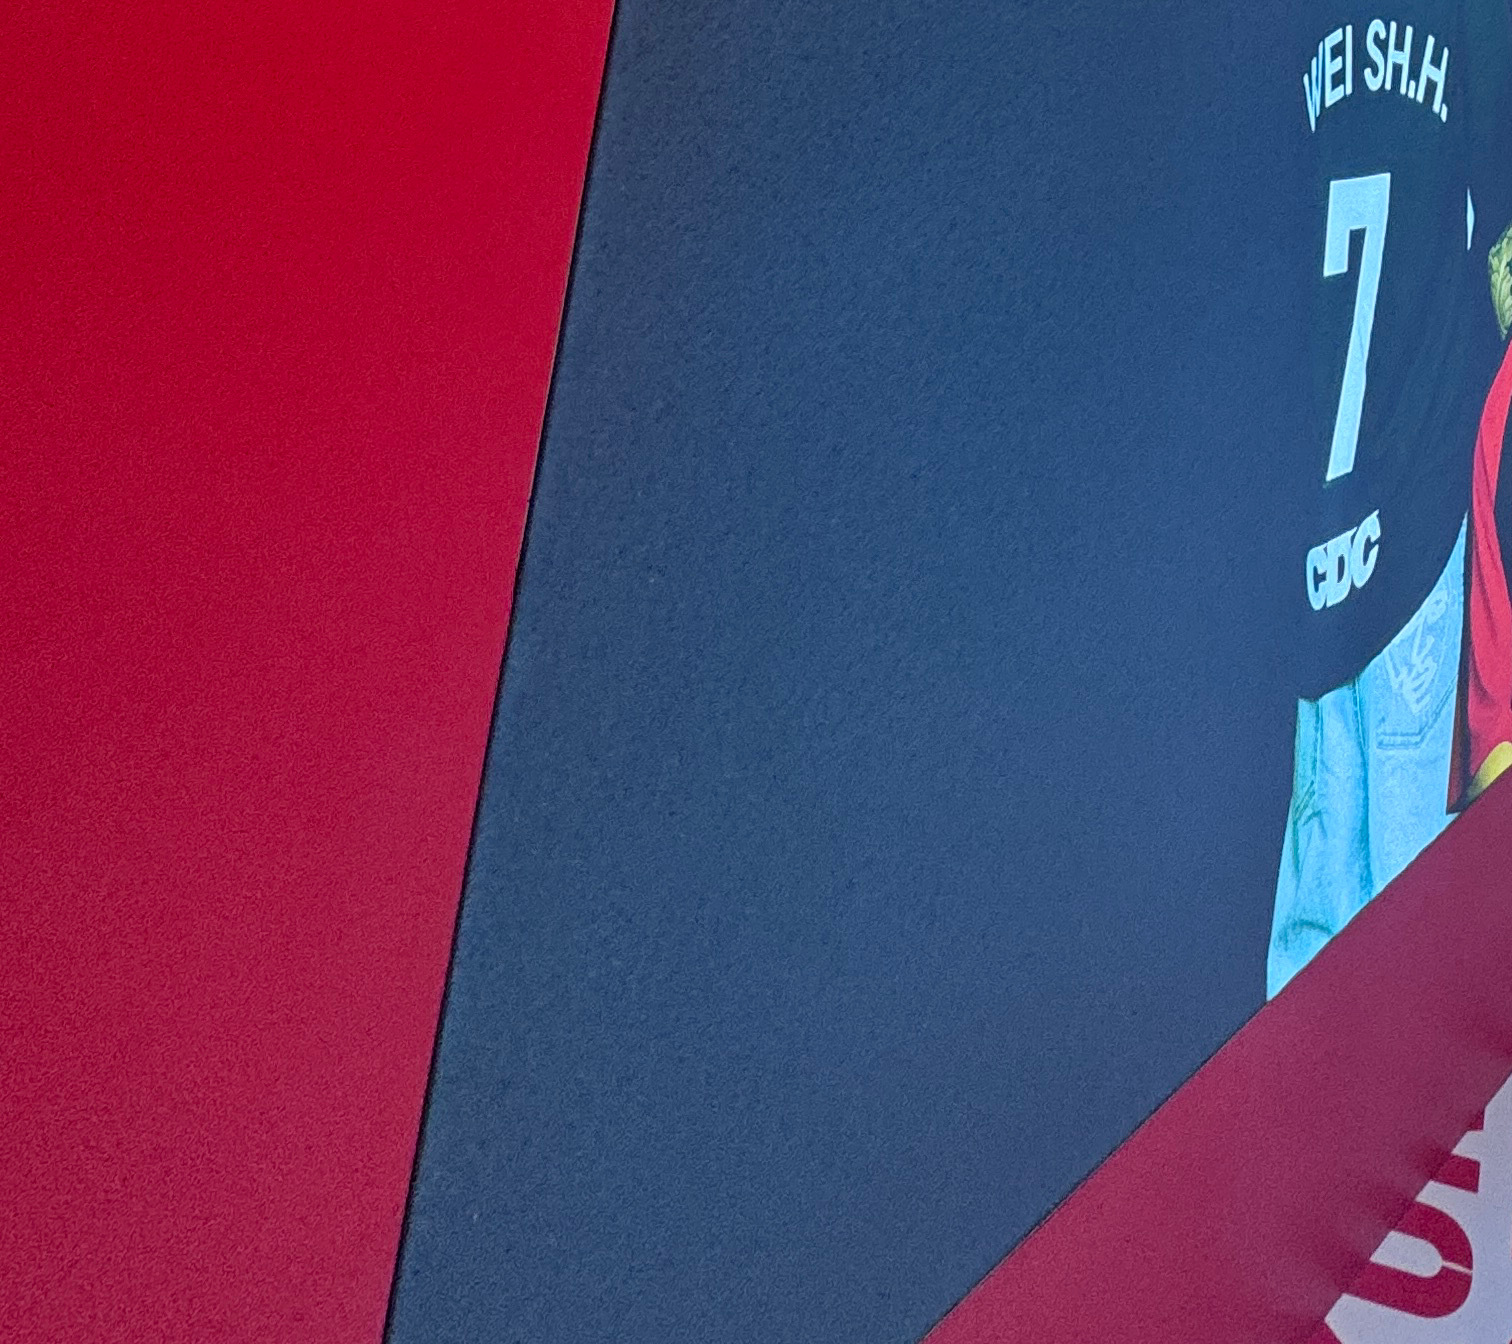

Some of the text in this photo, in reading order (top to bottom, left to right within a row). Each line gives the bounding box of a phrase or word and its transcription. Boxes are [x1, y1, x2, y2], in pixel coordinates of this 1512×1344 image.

[1303, 19, 1449, 133] WEI SH.H.
[1323, 172, 1391, 482] 7
[1306, 508, 1382, 611] CDC
